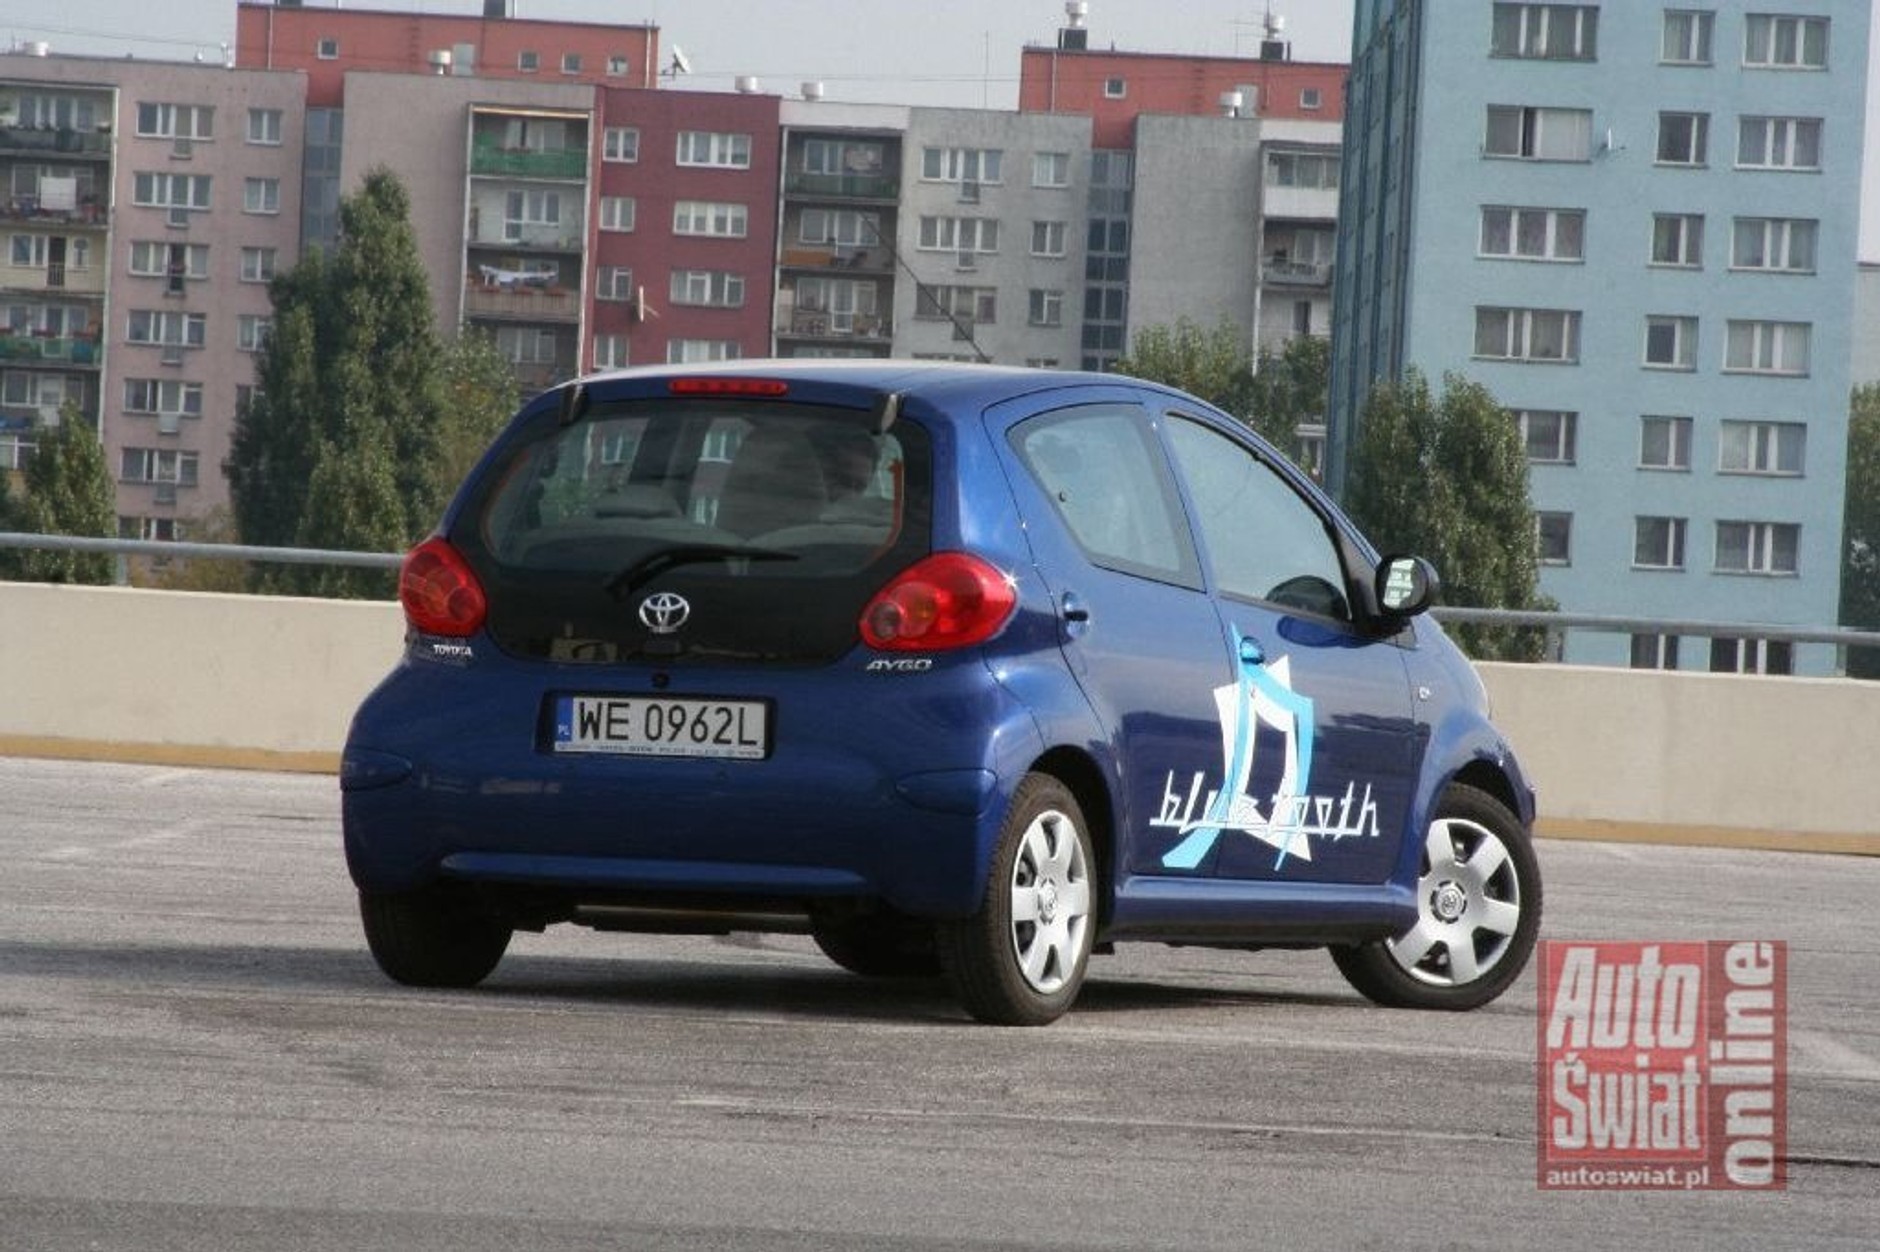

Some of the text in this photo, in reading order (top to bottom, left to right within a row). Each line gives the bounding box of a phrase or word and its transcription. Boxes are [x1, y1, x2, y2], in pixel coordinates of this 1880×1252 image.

[433, 644, 473, 657] TOYOTA
[866, 659, 932, 671] AYGO
[579, 701, 757, 745] WE 0962L
